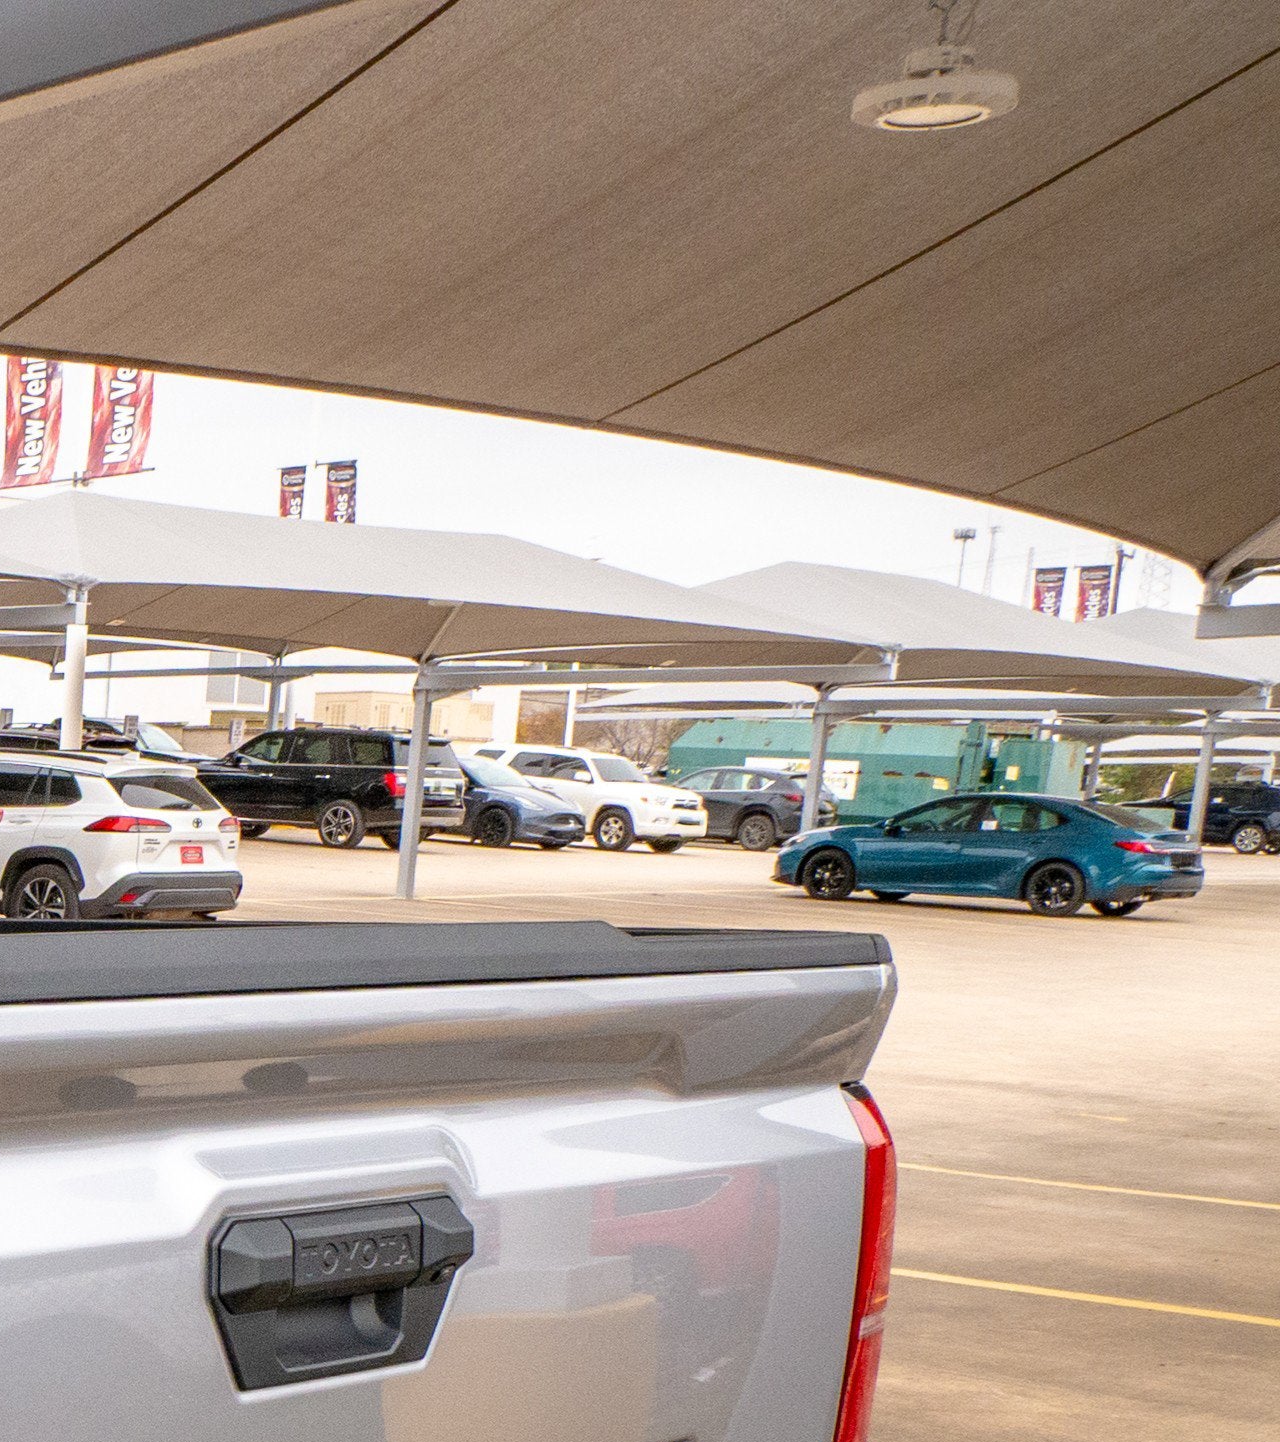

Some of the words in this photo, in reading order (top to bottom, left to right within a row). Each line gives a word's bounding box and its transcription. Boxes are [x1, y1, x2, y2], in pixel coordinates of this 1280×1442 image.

[15, 419, 45, 476] New
[102, 405, 136, 464] New
[301, 1234, 415, 1277] TOYOTA
